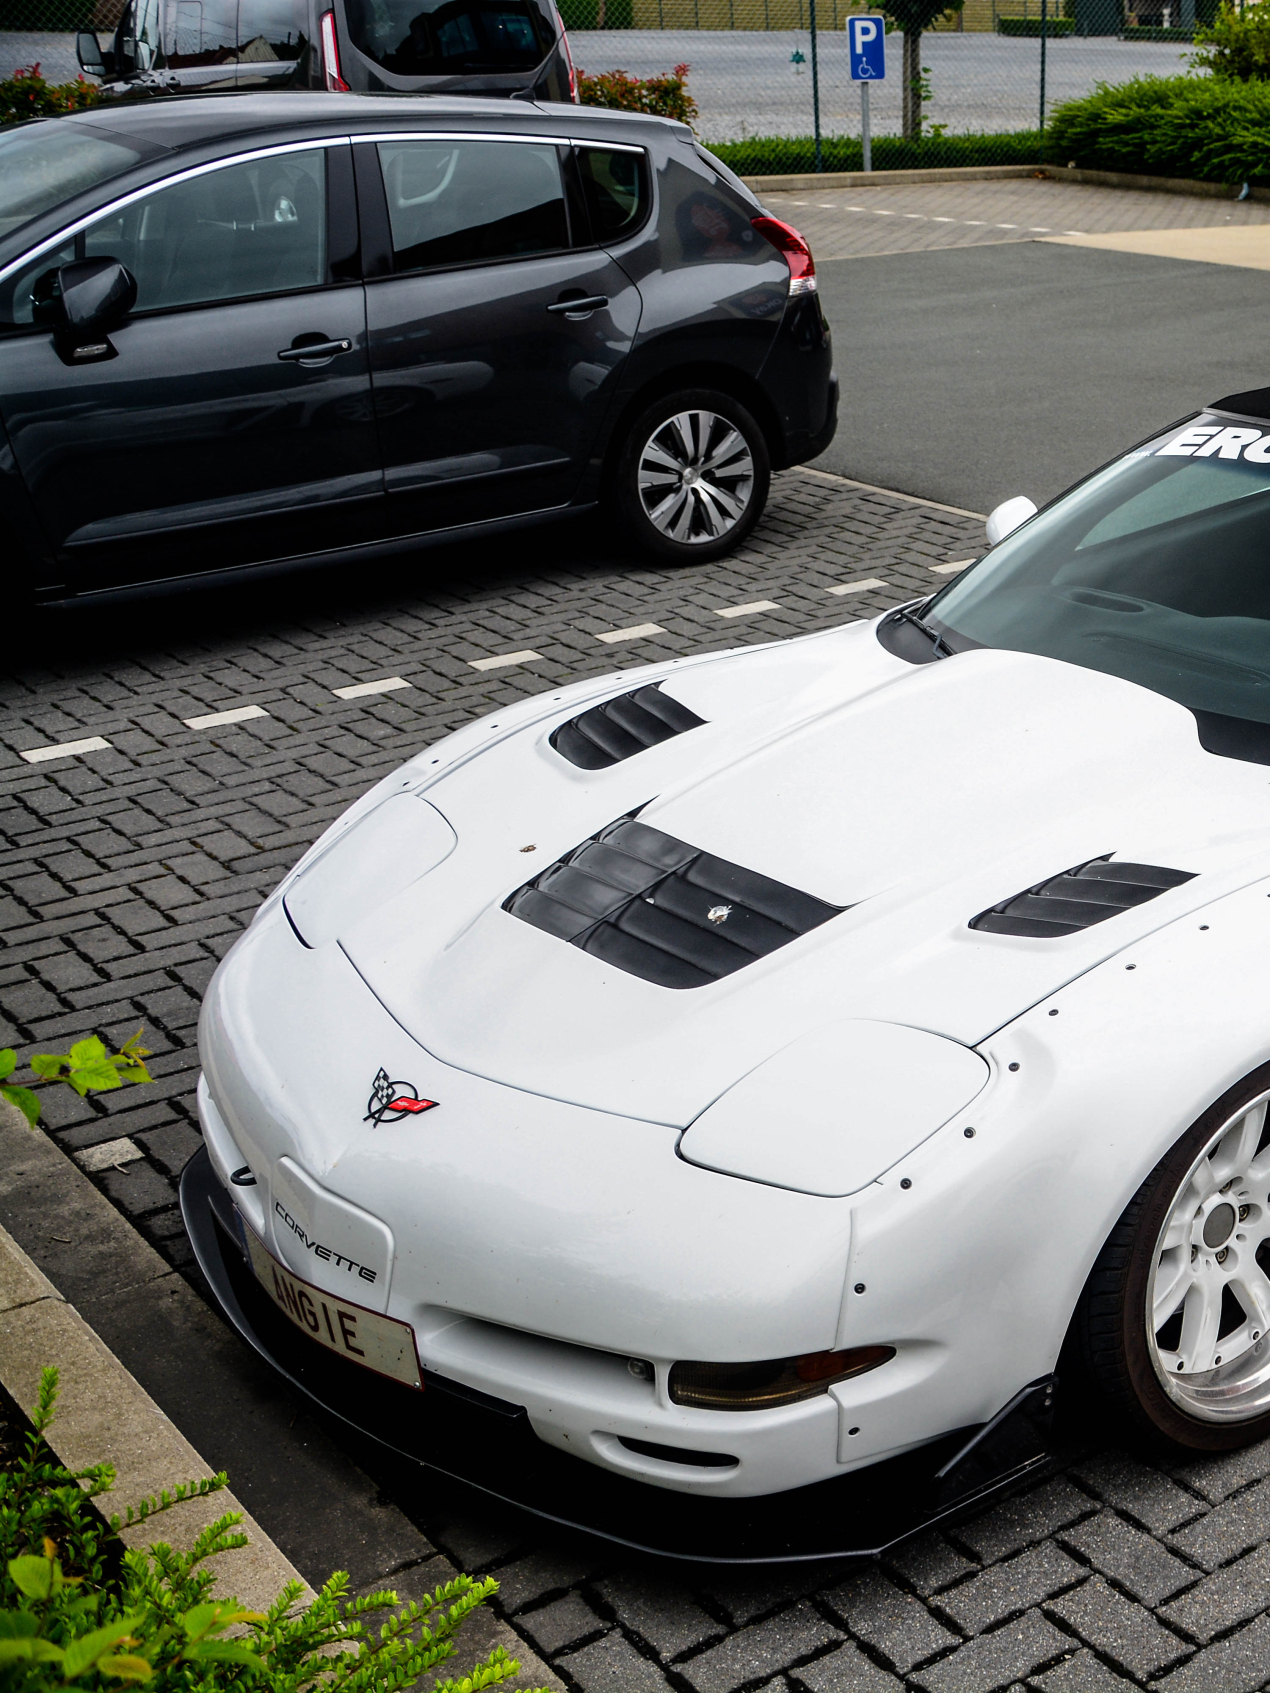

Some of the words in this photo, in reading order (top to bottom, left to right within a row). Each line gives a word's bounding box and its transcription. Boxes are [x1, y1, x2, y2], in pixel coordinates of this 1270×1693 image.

[854, 20, 877, 54] P
[275, 1200, 378, 1285] CORVETTE
[271, 1265, 366, 1358] ANGIE
